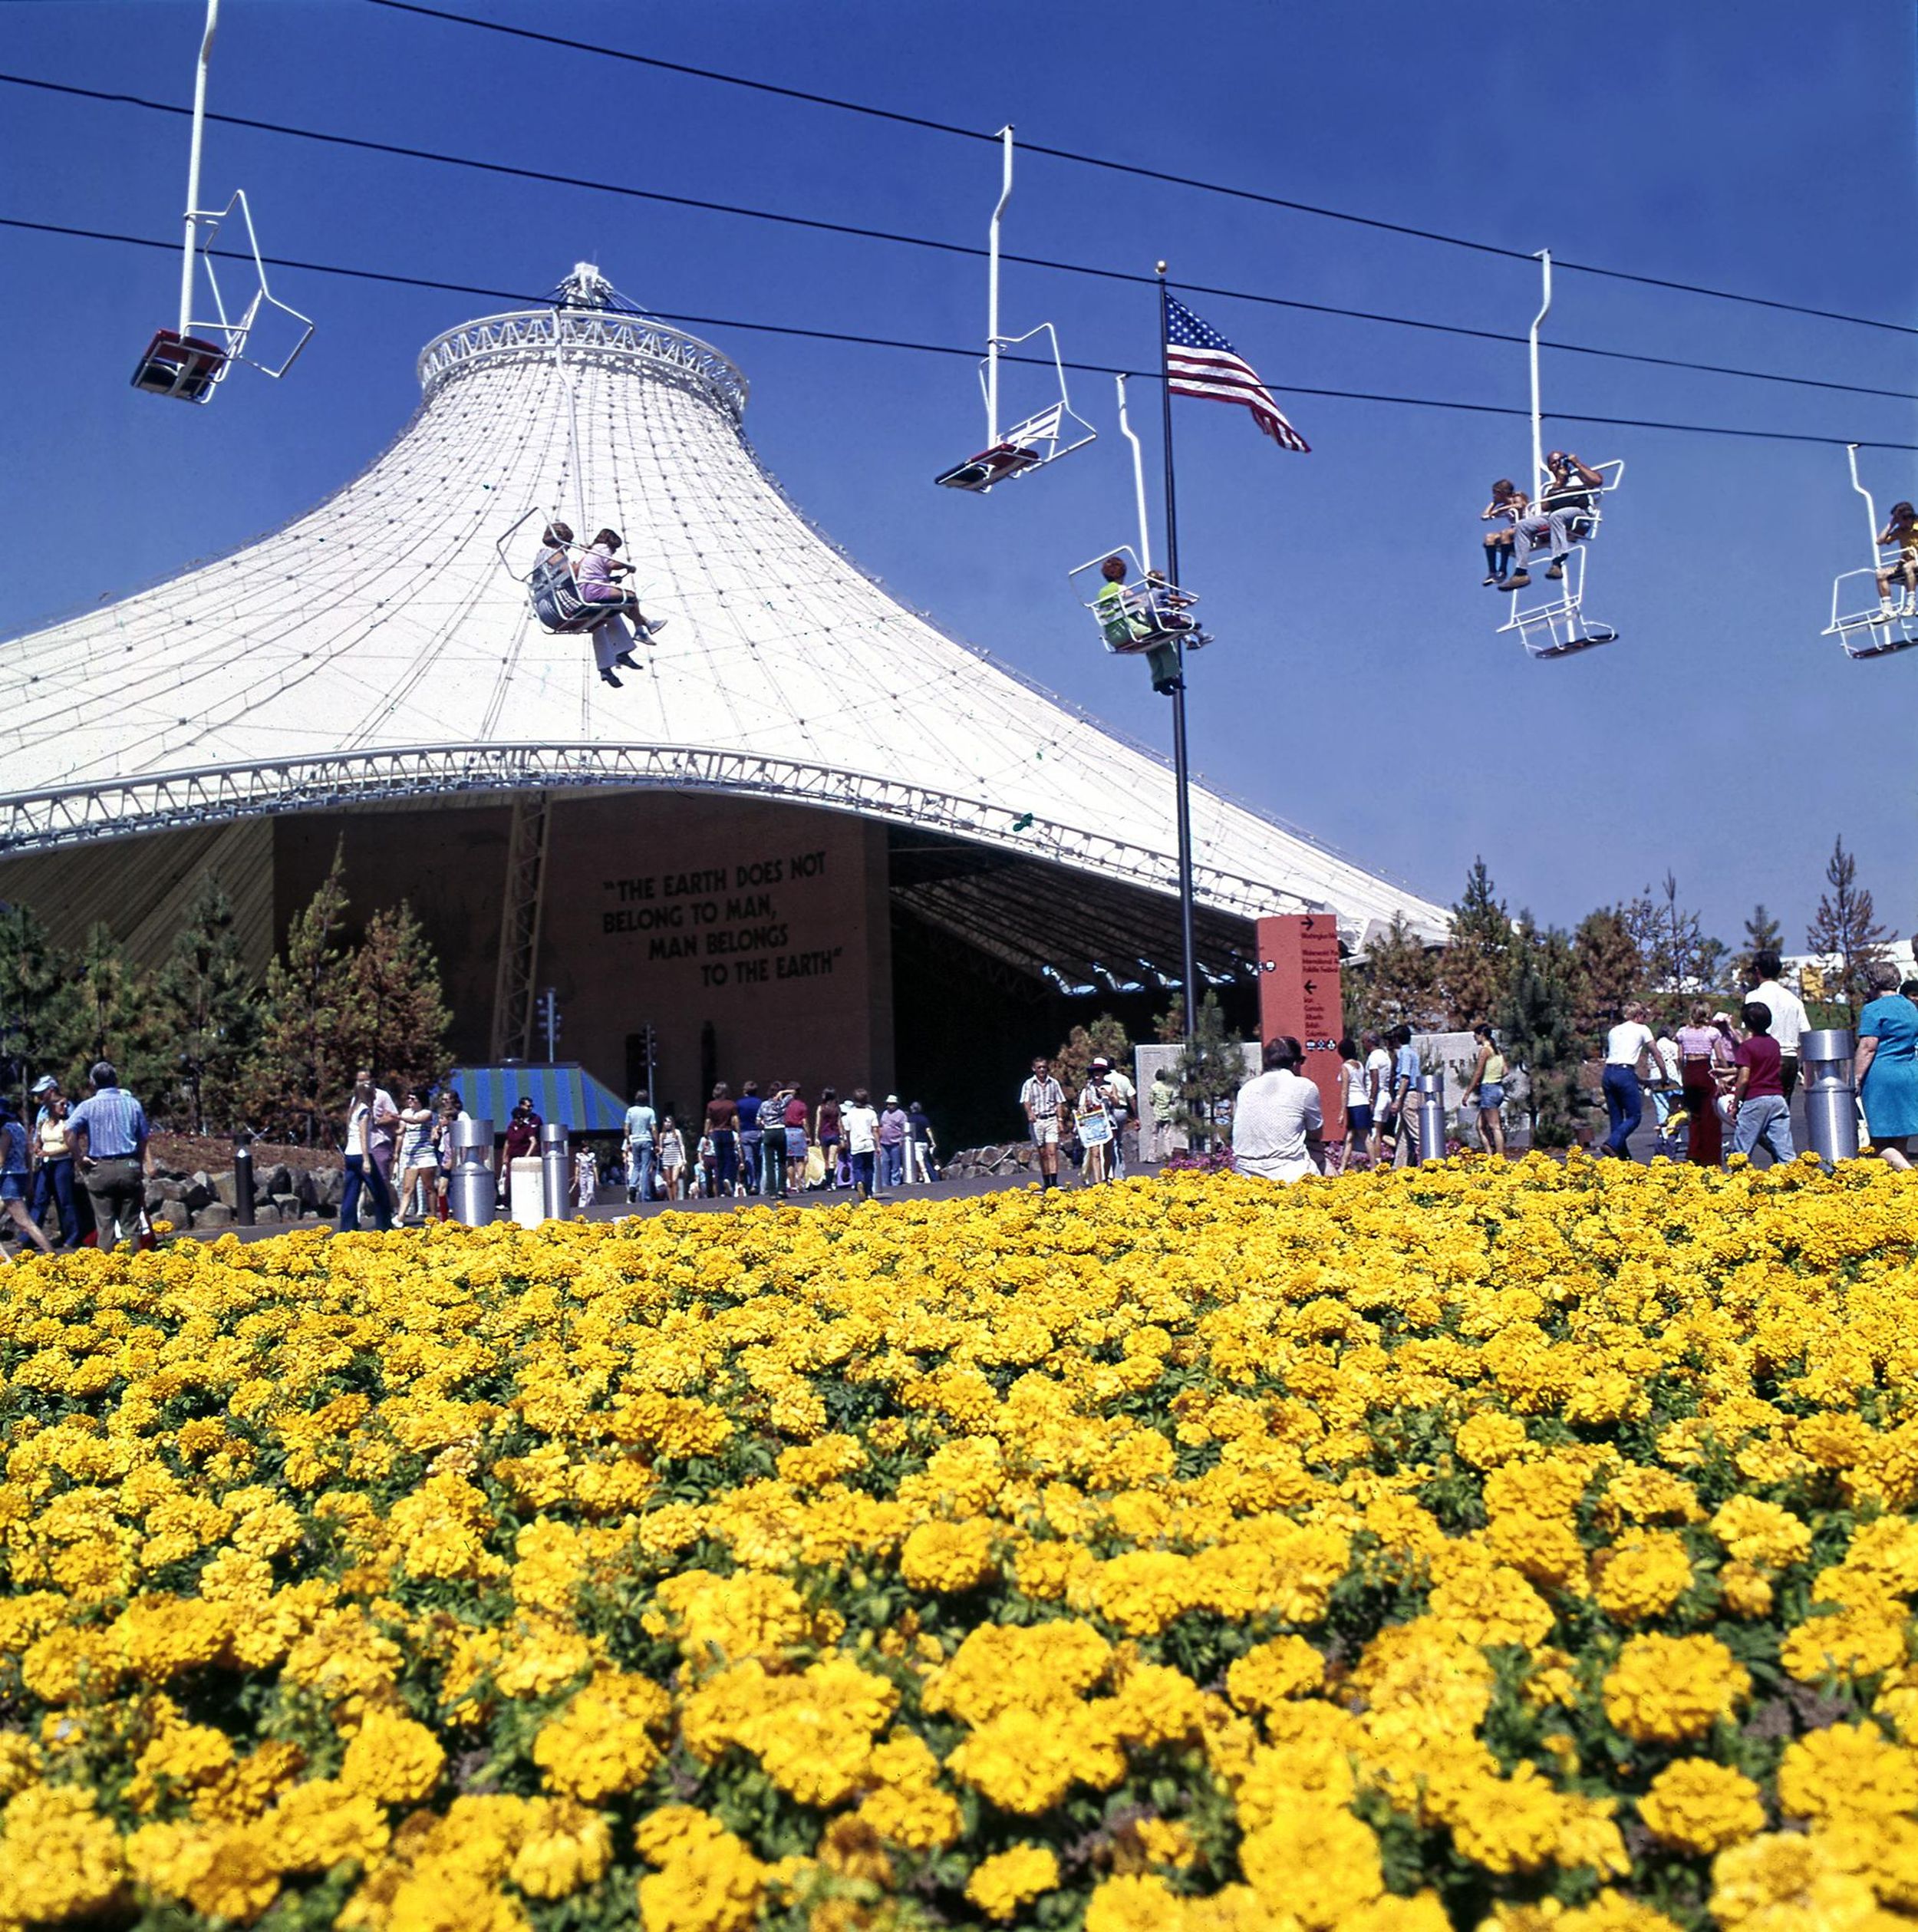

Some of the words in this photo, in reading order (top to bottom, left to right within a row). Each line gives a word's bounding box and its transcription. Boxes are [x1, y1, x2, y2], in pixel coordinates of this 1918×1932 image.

[603, 877, 654, 902] "THE
[664, 869, 727, 897] EARTH
[737, 859, 783, 888] DOES
[790, 851, 826, 879] NOT
[602, 905, 683, 934] BELONG
[690, 902, 717, 925] TO
[725, 894, 778, 921] MAN,
[648, 935, 697, 960] MAN
[707, 923, 788, 954] BELONGS
[701, 963, 727, 987] TO
[734, 958, 769, 984] THE
[776, 946, 843, 979] EARTH"
